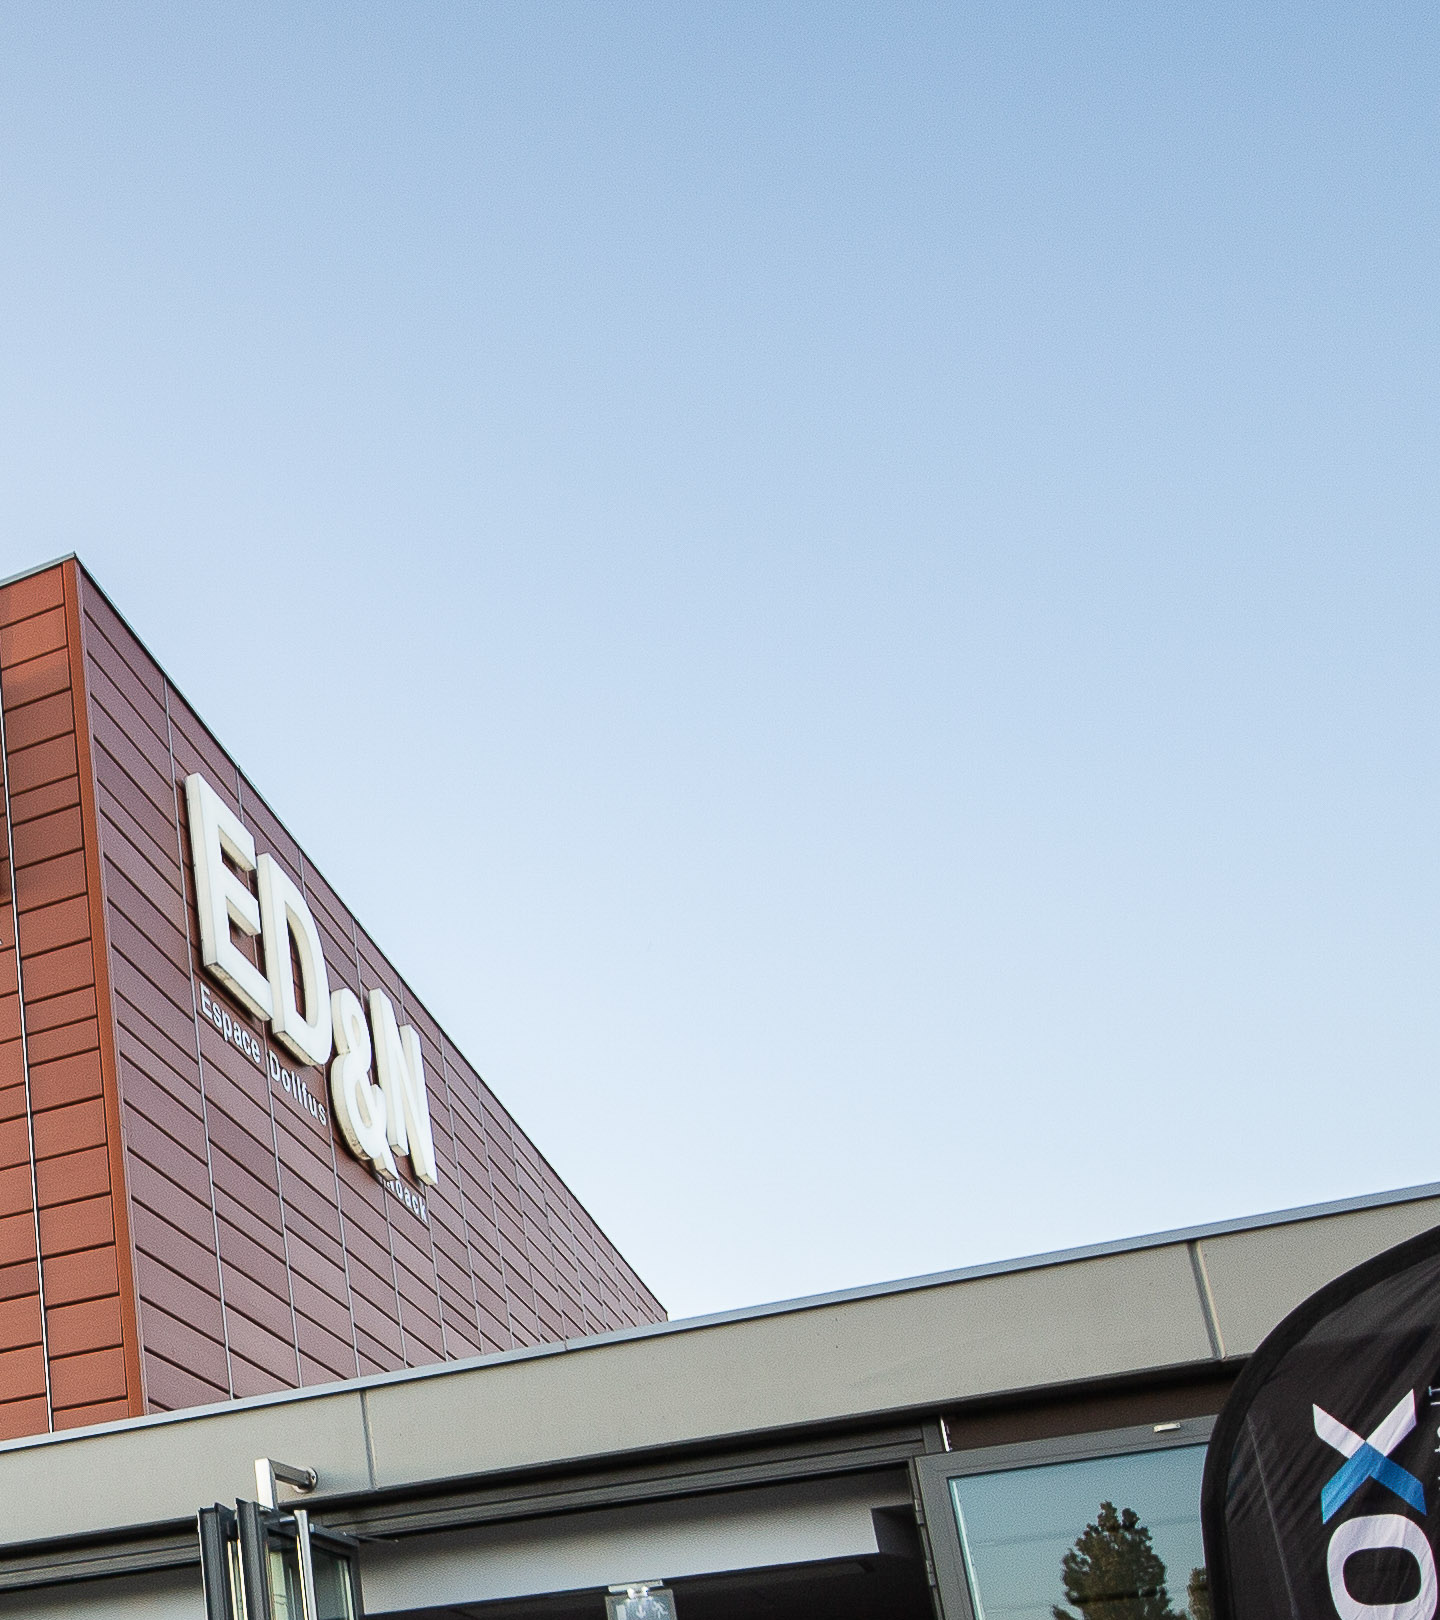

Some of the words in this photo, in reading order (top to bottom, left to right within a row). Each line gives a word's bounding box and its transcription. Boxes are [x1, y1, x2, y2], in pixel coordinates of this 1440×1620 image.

[186, 773, 439, 1186] ED&N
[199, 981, 261, 1065] Espace
[269, 1048, 328, 1128] Dollfus
